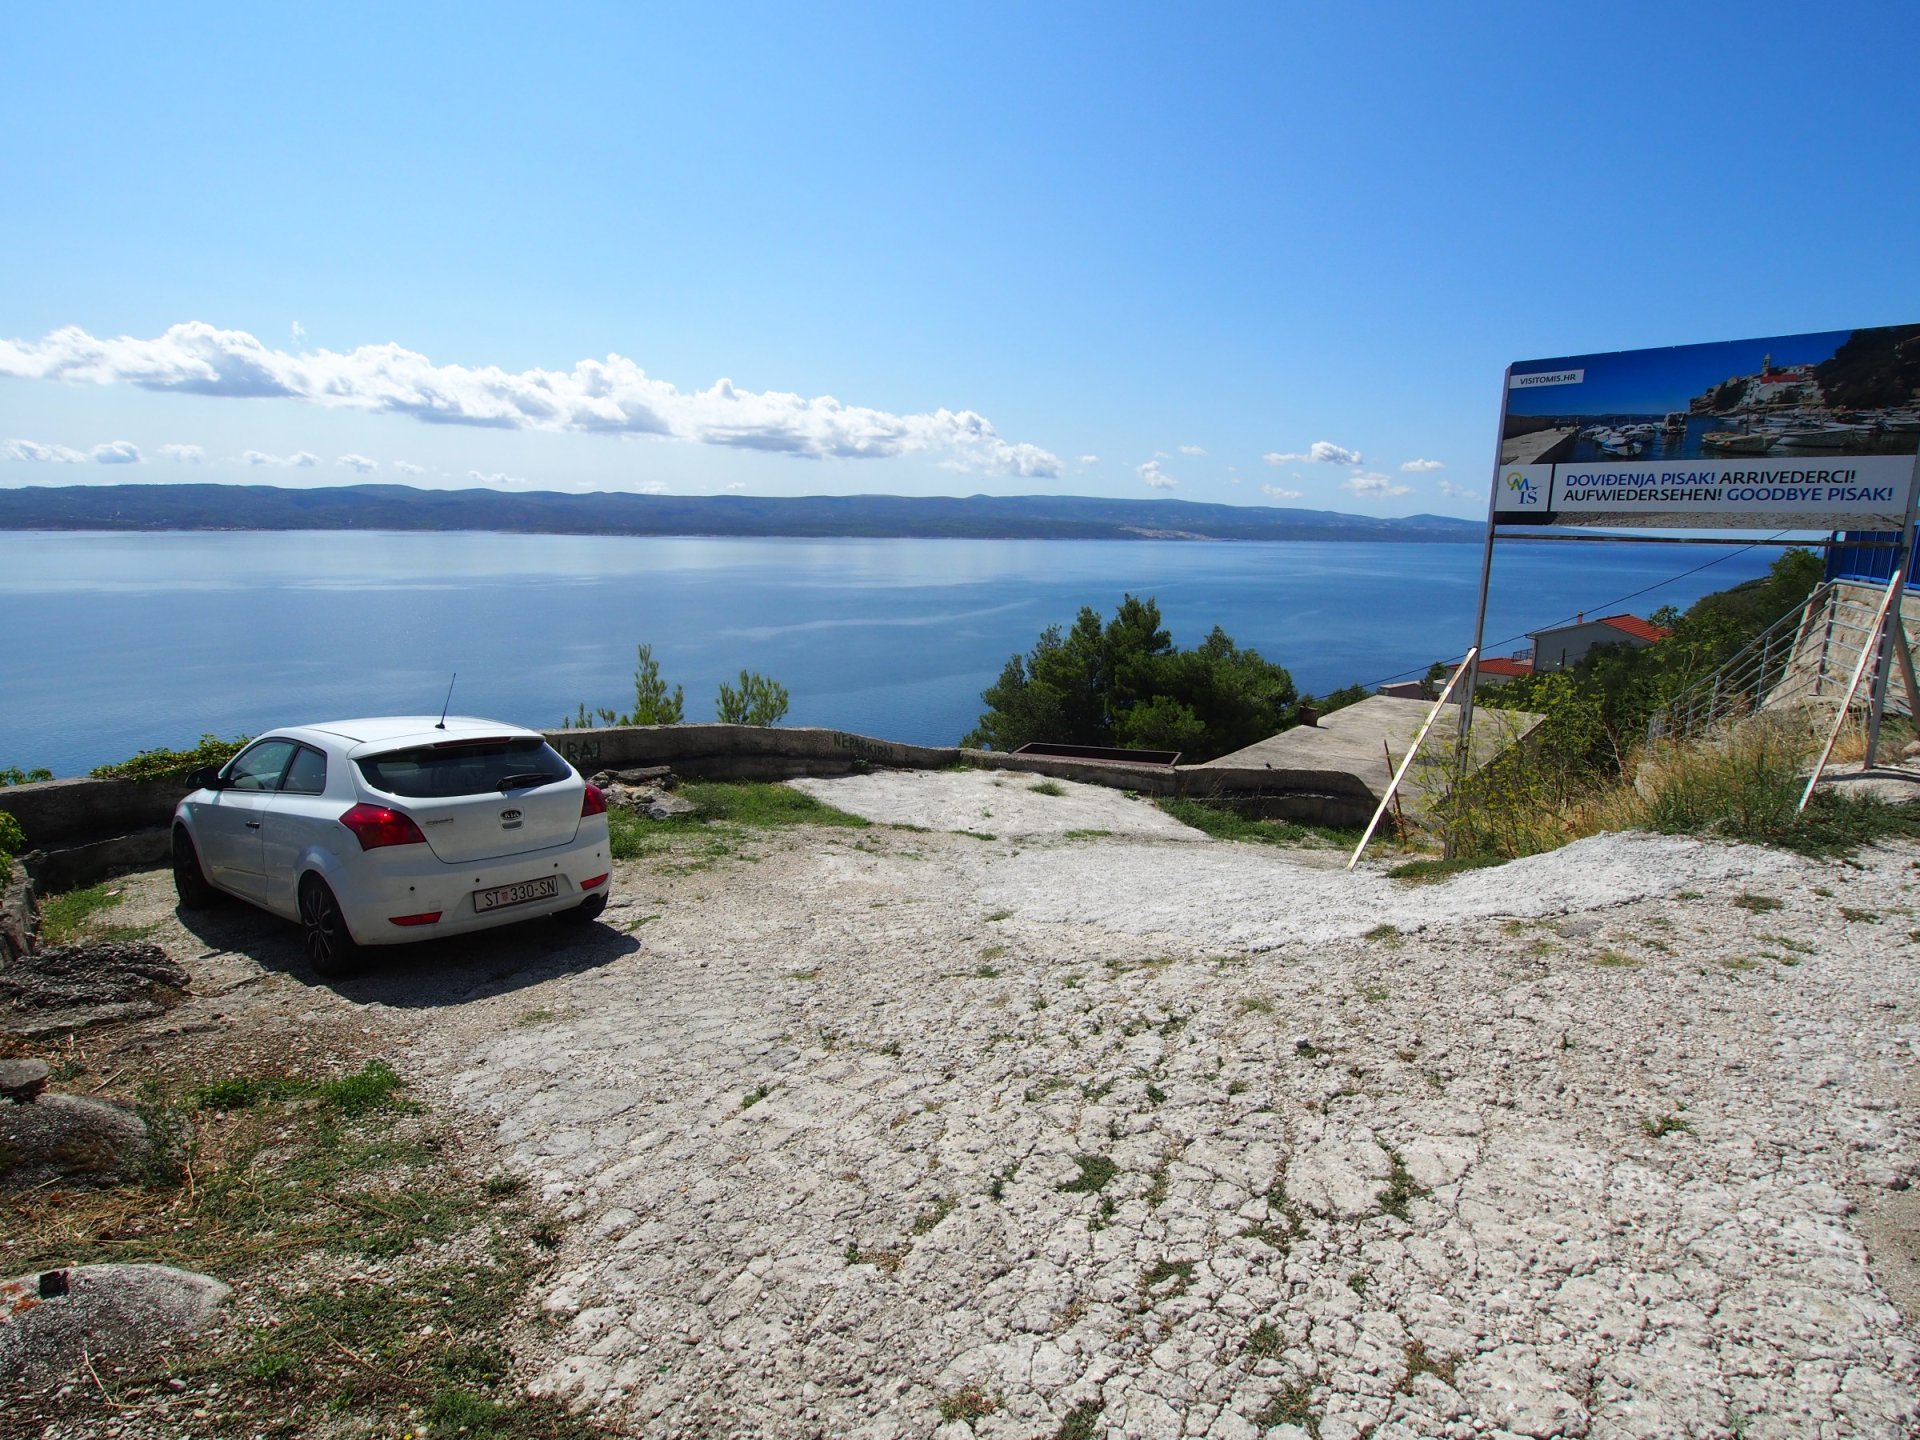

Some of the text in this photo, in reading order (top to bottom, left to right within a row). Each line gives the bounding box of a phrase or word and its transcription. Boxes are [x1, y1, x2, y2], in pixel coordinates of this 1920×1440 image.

[1519, 373, 1576, 385] VISITOMIS.HR
[1565, 470, 1856, 488] DOVIĐENJA PISAK! ARRIVEDERCI!
[1563, 486, 1893, 502] AUFWIEDERSEHEN! GOODBYE PISAK!
[485, 879, 556, 907] ST 330-SN
